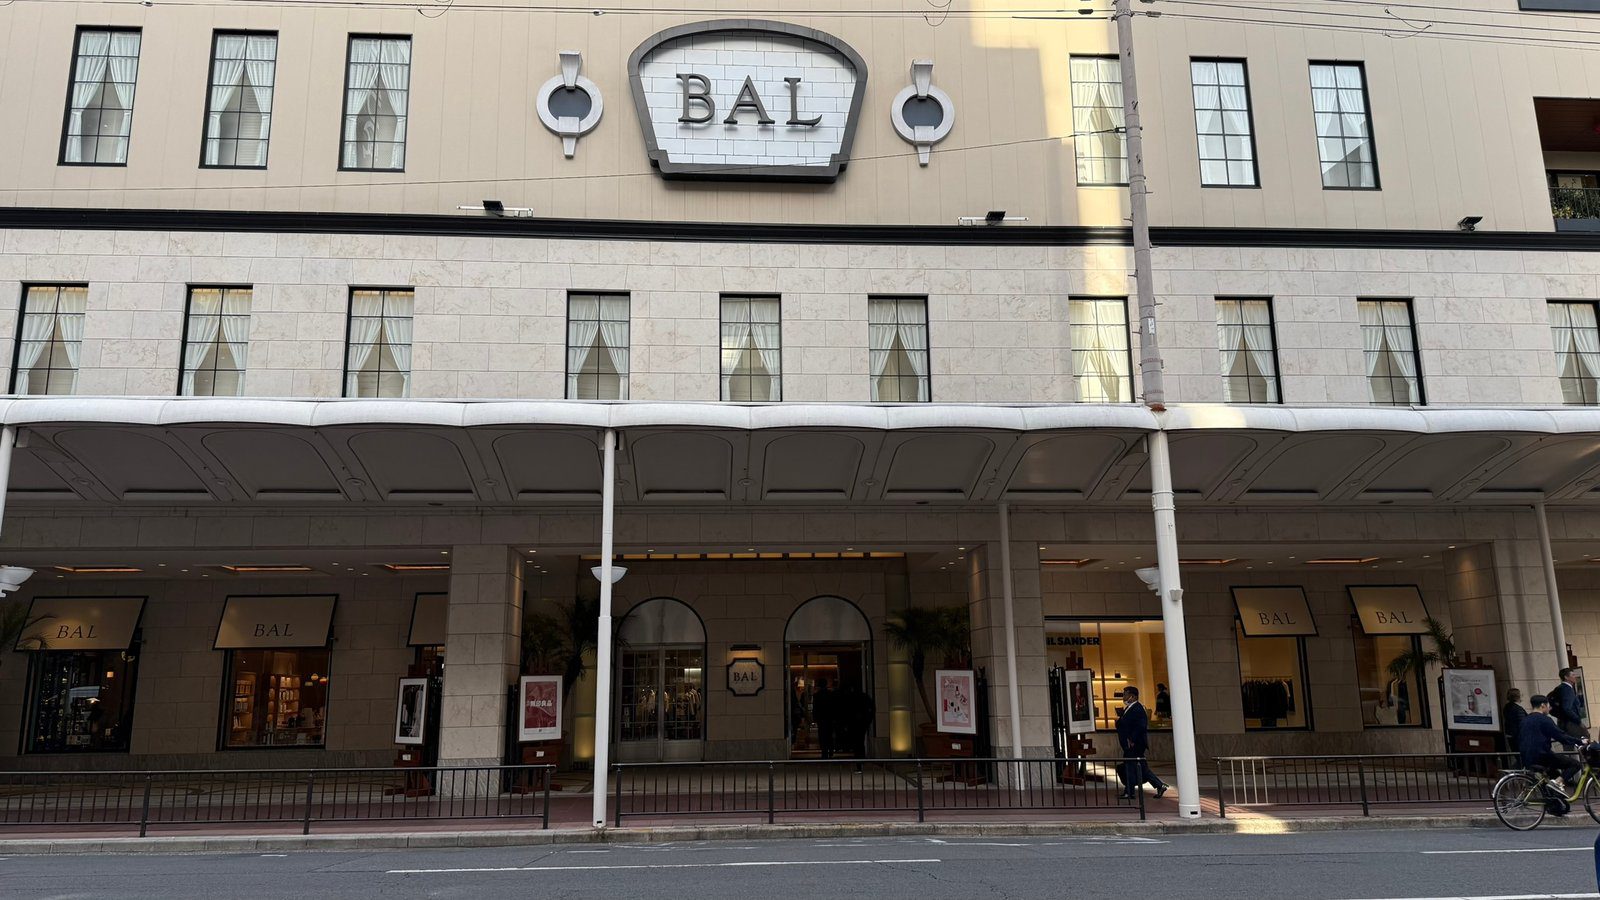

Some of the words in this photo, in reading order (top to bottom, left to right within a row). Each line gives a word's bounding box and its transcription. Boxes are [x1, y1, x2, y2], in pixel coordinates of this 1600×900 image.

[676, 73, 822, 127] BAL
[1259, 613, 1296, 624] BAL
[1376, 611, 1413, 623] BAL
[56, 625, 97, 638] BAL
[254, 623, 294, 637] BAL
[1046, 636, 1056, 646] IL
[1057, 636, 1100, 646] SANDER
[734, 671, 759, 681] BAL
